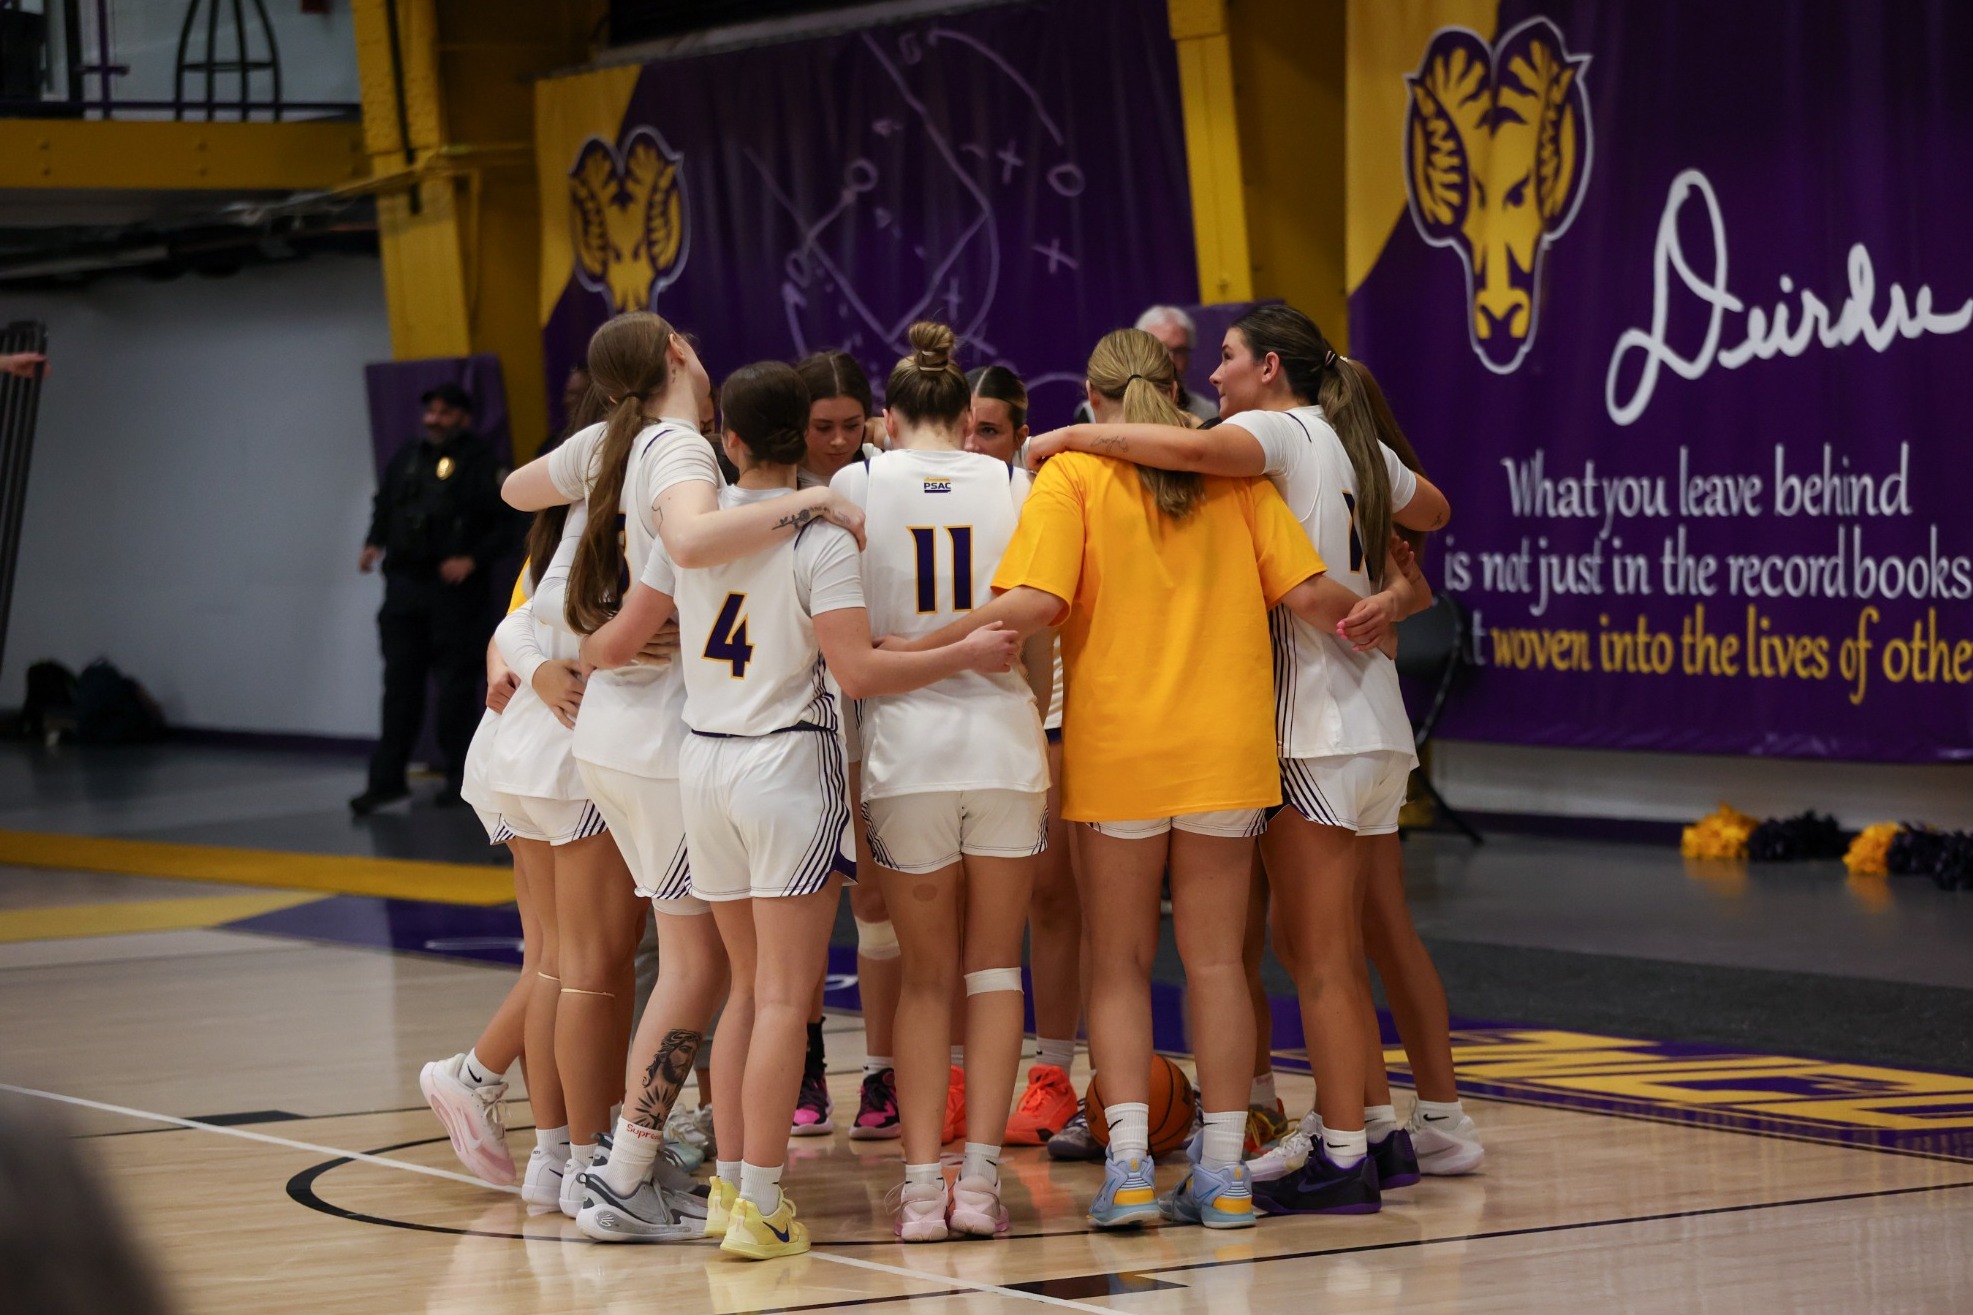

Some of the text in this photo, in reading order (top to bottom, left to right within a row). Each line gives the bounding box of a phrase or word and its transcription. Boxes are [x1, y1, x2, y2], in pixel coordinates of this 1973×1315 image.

[923, 482, 951, 490] PSAC
[1501, 441, 1912, 540] What you leave behind
[906, 524, 974, 615] 11
[1444, 523, 1973, 617] is not just in the record books
[701, 591, 756, 680] 4
[1491, 626, 1593, 673] woven
[1599, 613, 1674, 675] into
[1681, 603, 1739, 677] the
[1747, 603, 1830, 680] lives
[1839, 605, 1880, 706] of
